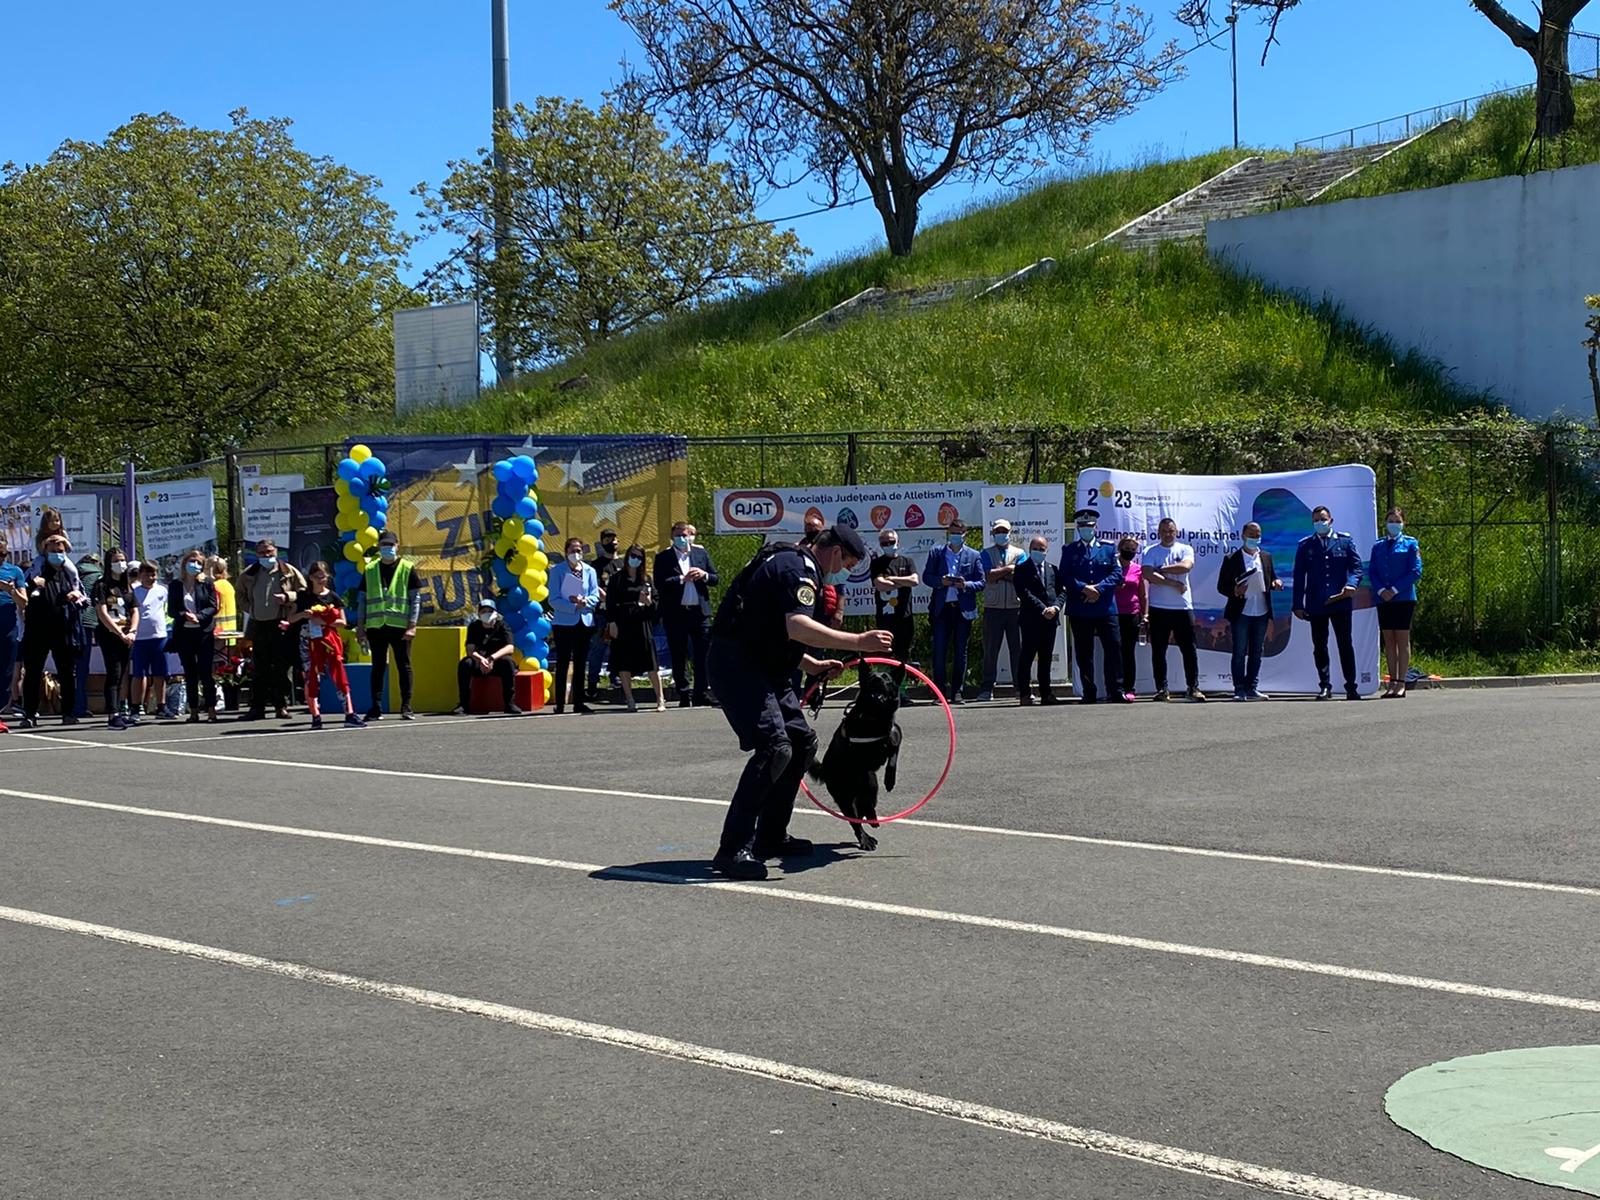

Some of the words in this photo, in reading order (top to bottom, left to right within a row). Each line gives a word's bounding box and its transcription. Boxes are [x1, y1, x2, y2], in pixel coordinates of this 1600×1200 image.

[888, 492, 902, 500] de
[903, 490, 945, 500] Atletism
[946, 489, 974, 499] Timiș
[734, 502, 773, 516] AJAT
[1188, 528, 1211, 542] prin
[1213, 529, 1240, 541] tine!
